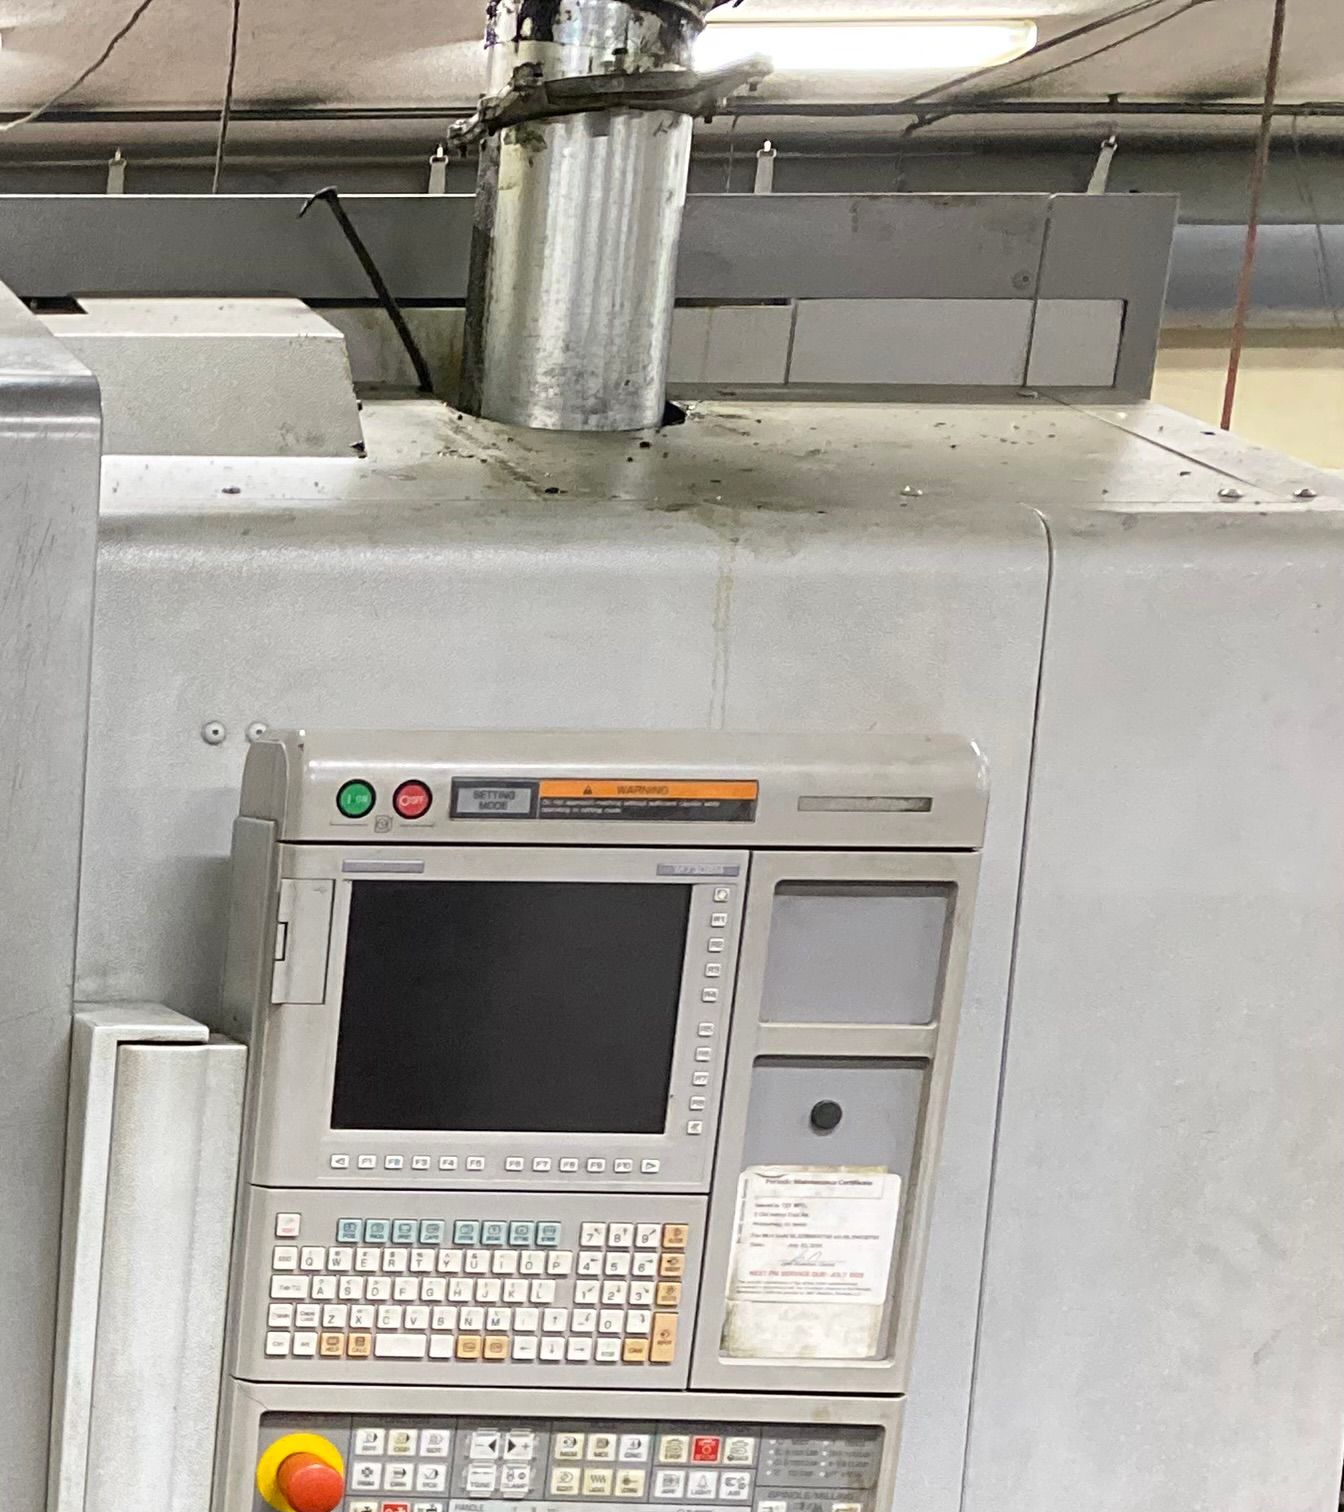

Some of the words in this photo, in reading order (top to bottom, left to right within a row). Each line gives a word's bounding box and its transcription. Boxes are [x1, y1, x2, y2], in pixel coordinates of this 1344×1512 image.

[617, 785, 669, 795] WARNING
[473, 791, 515, 799] SETTING
[479, 802, 507, 810] MODE
